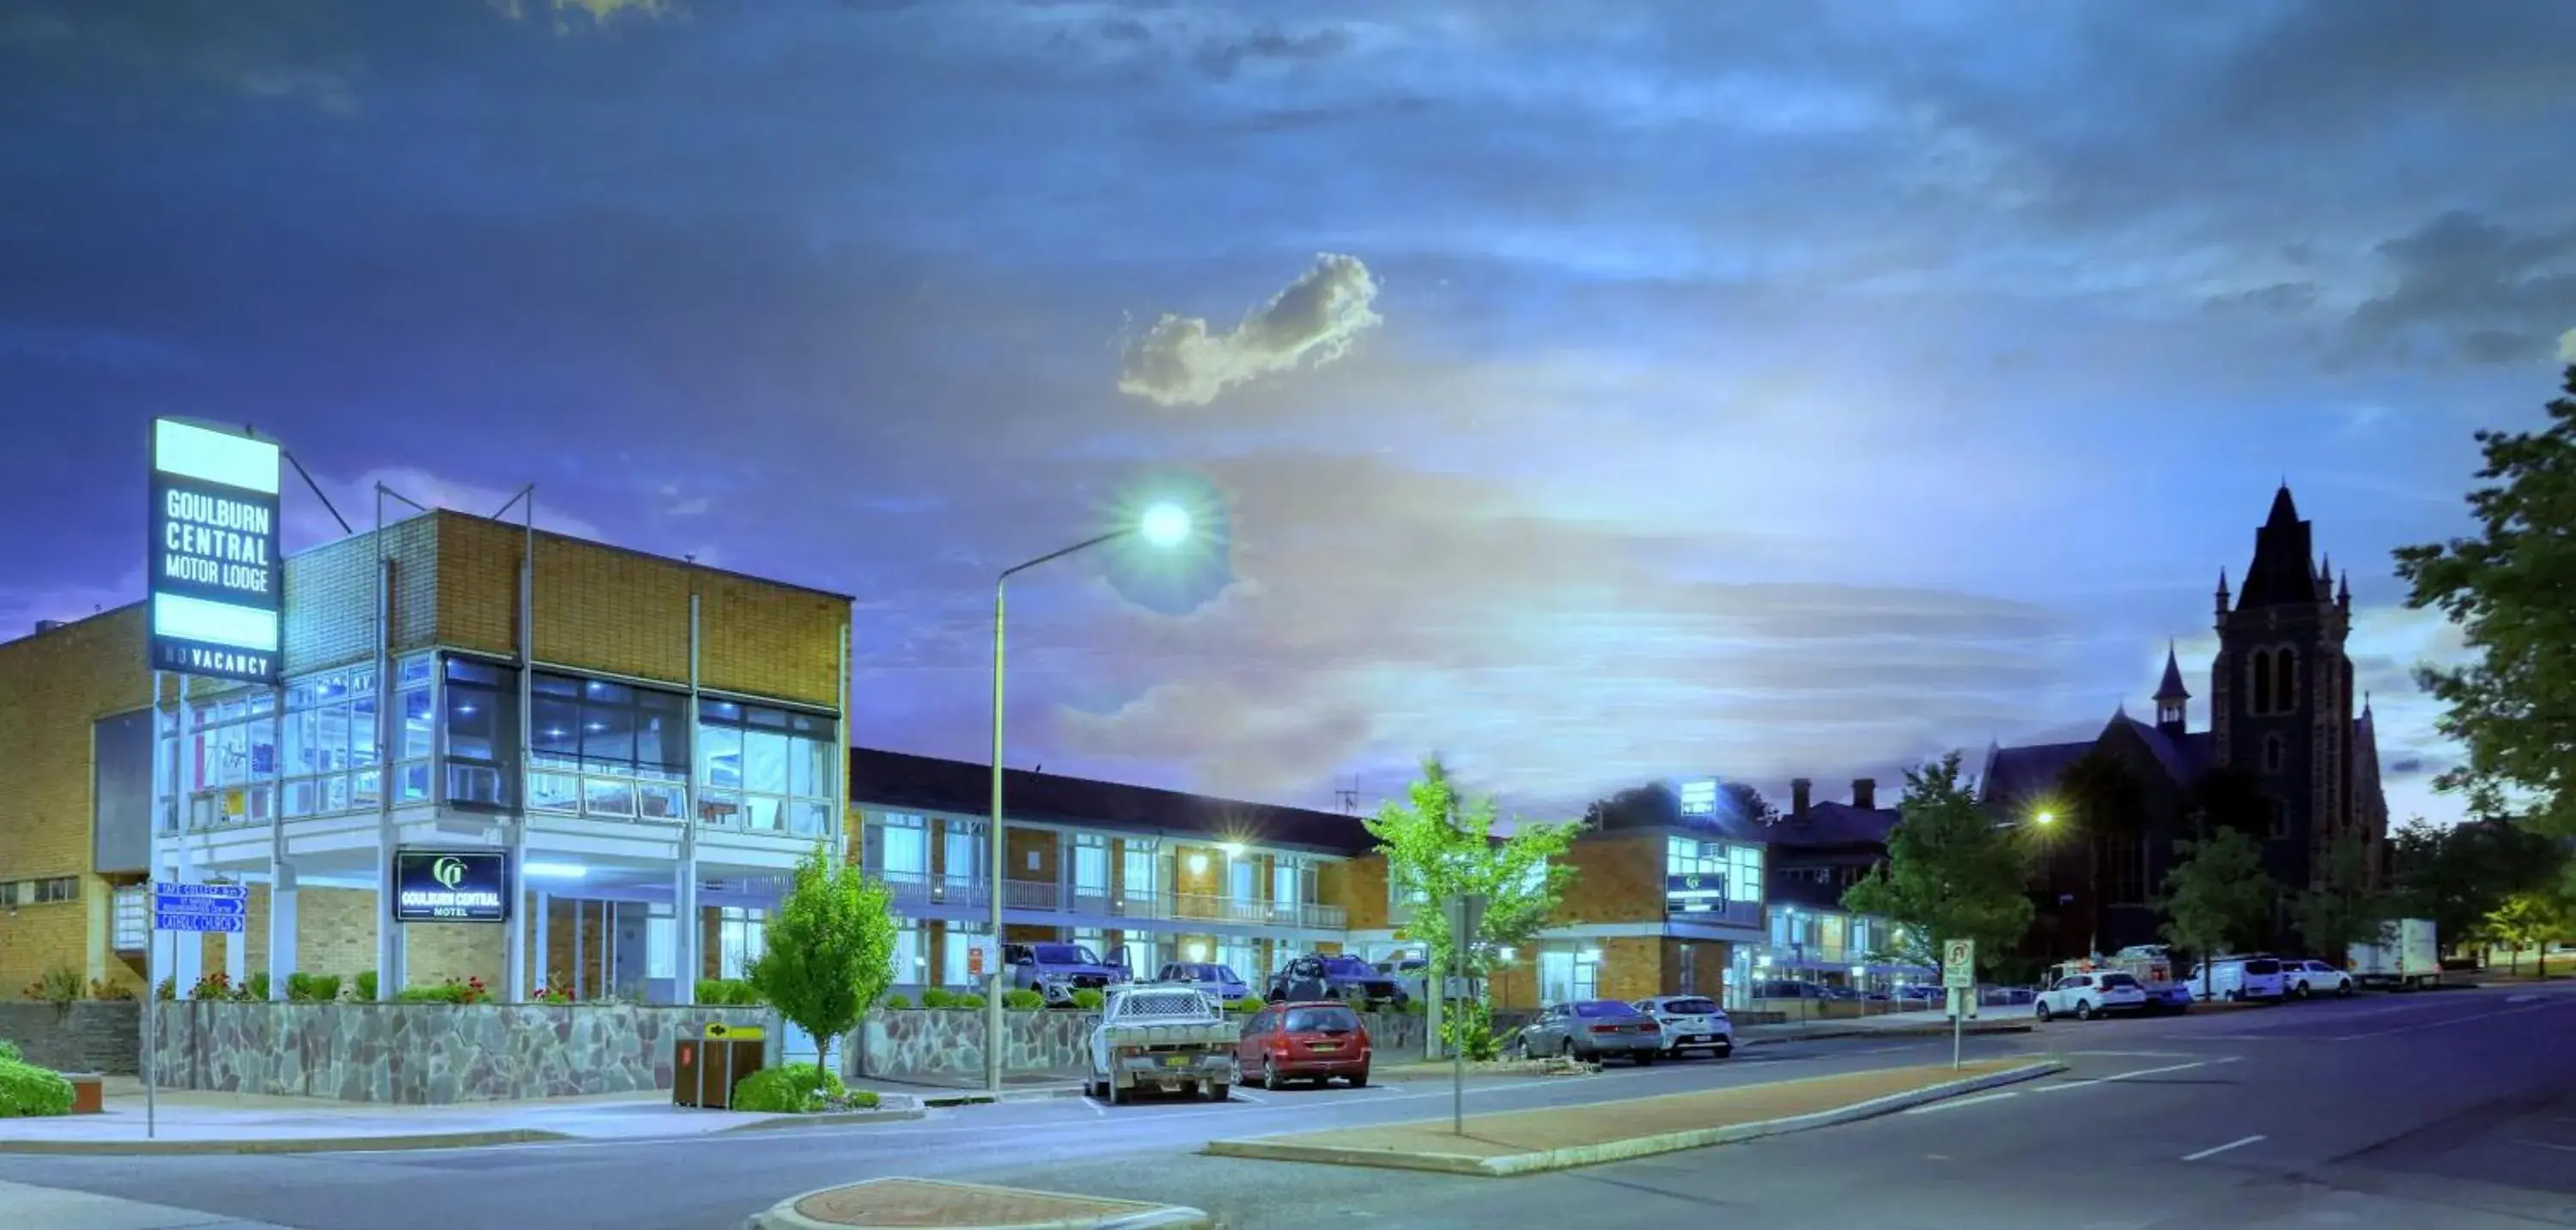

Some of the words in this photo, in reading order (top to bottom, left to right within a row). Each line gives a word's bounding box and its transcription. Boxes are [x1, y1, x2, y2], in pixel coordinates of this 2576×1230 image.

[167, 489, 269, 535] GOULBURN
[166, 521, 268, 566] CENTRAL
[166, 554, 218, 584] MOTOR
[222, 563, 268, 593] LODGE
[192, 648, 268, 676] VACANCY
[401, 891, 455, 906] GOULBURN
[456, 892, 501, 907] CENTRAL
[434, 907, 468, 916] MOTEL
[163, 914, 198, 930] CATHOLIC
